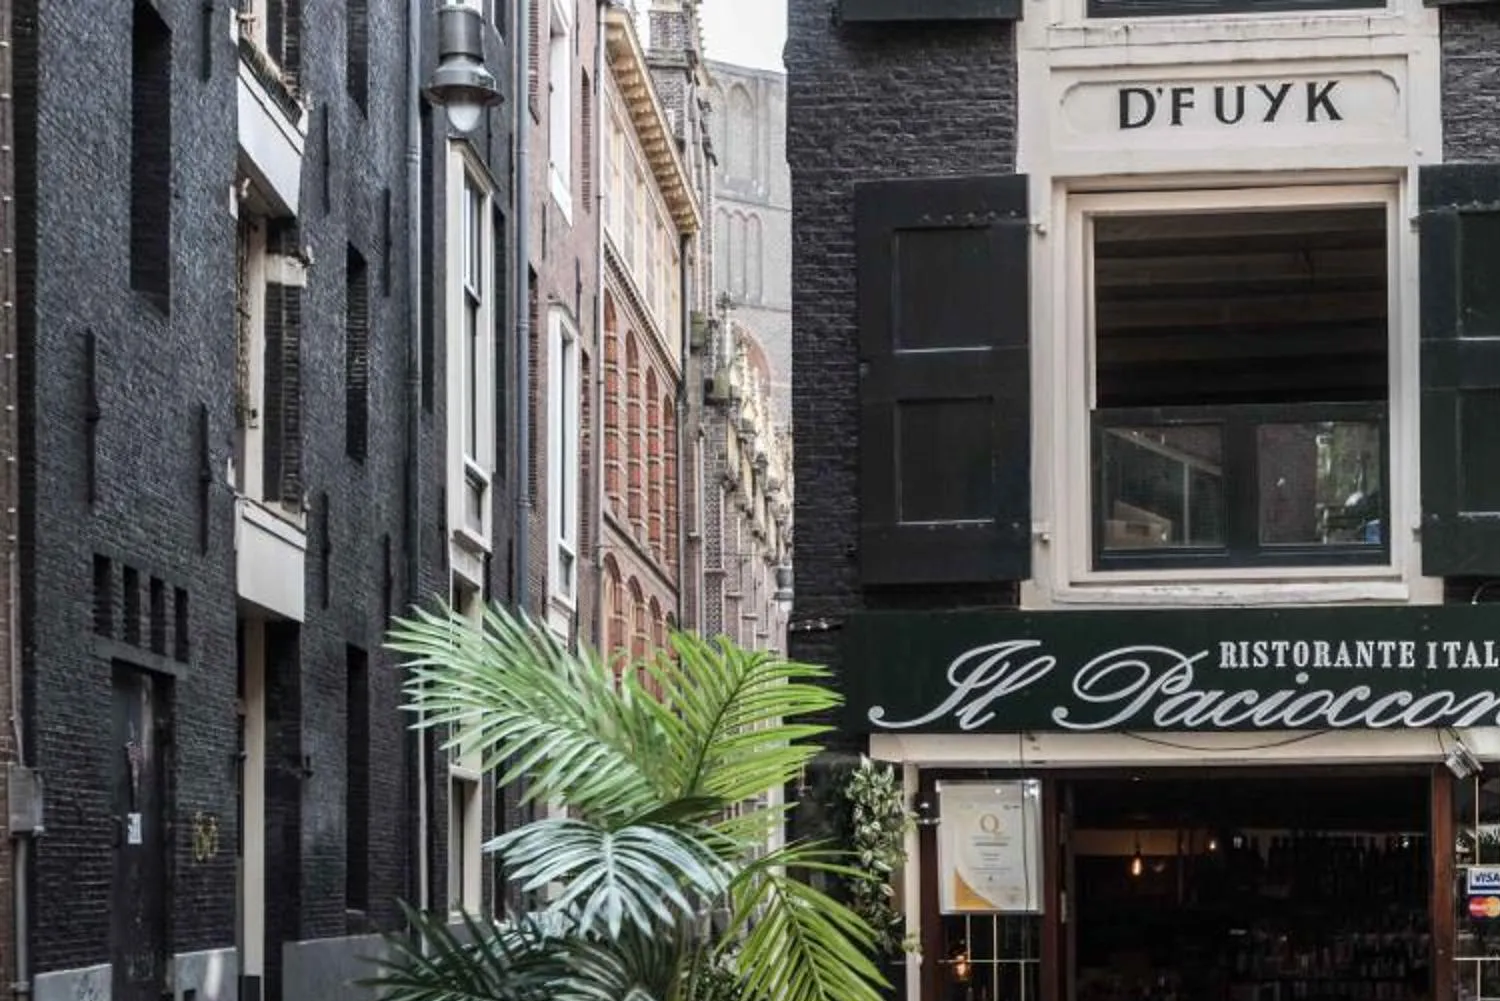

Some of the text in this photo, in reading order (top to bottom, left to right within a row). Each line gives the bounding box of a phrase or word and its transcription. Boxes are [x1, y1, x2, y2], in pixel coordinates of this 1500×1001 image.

[1219, 640, 1416, 669] RISTORANTE
[867, 639, 1057, 731] Il
[1475, 872, 1500, 884] VISA
